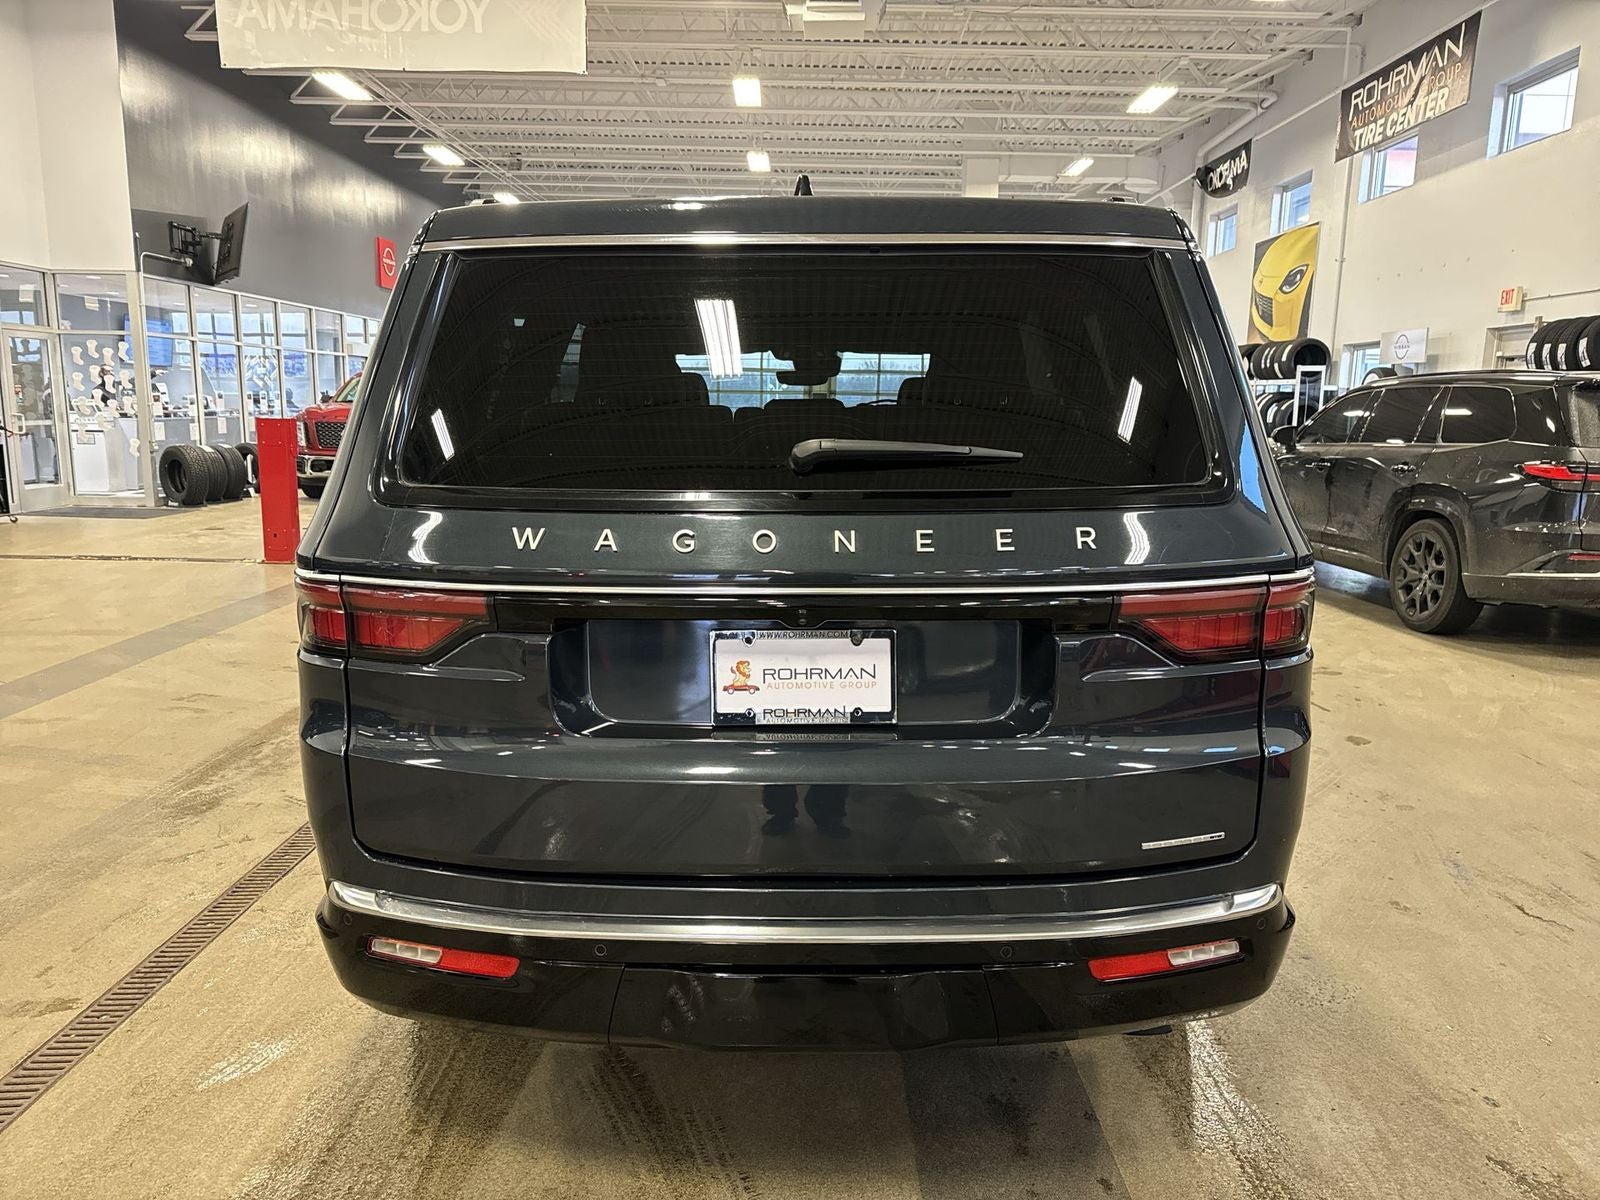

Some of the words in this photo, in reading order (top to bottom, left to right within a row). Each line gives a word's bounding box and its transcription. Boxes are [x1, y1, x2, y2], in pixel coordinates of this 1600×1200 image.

[1348, 22, 1465, 121] ROHRMAN
[1353, 117, 1386, 151] TIRE
[1386, 86, 1450, 137] CENTER
[1500, 288, 1514, 305] EXIT
[511, 525, 1098, 554] WAGONEER
[759, 630, 849, 640] WWW.ROHRMAN.COM
[762, 663, 876, 684] ROHRMAN
[766, 681, 835, 690] AUTOMOTIVE
[839, 681, 877, 689] GROUP
[762, 705, 846, 720] ROHRMAN
